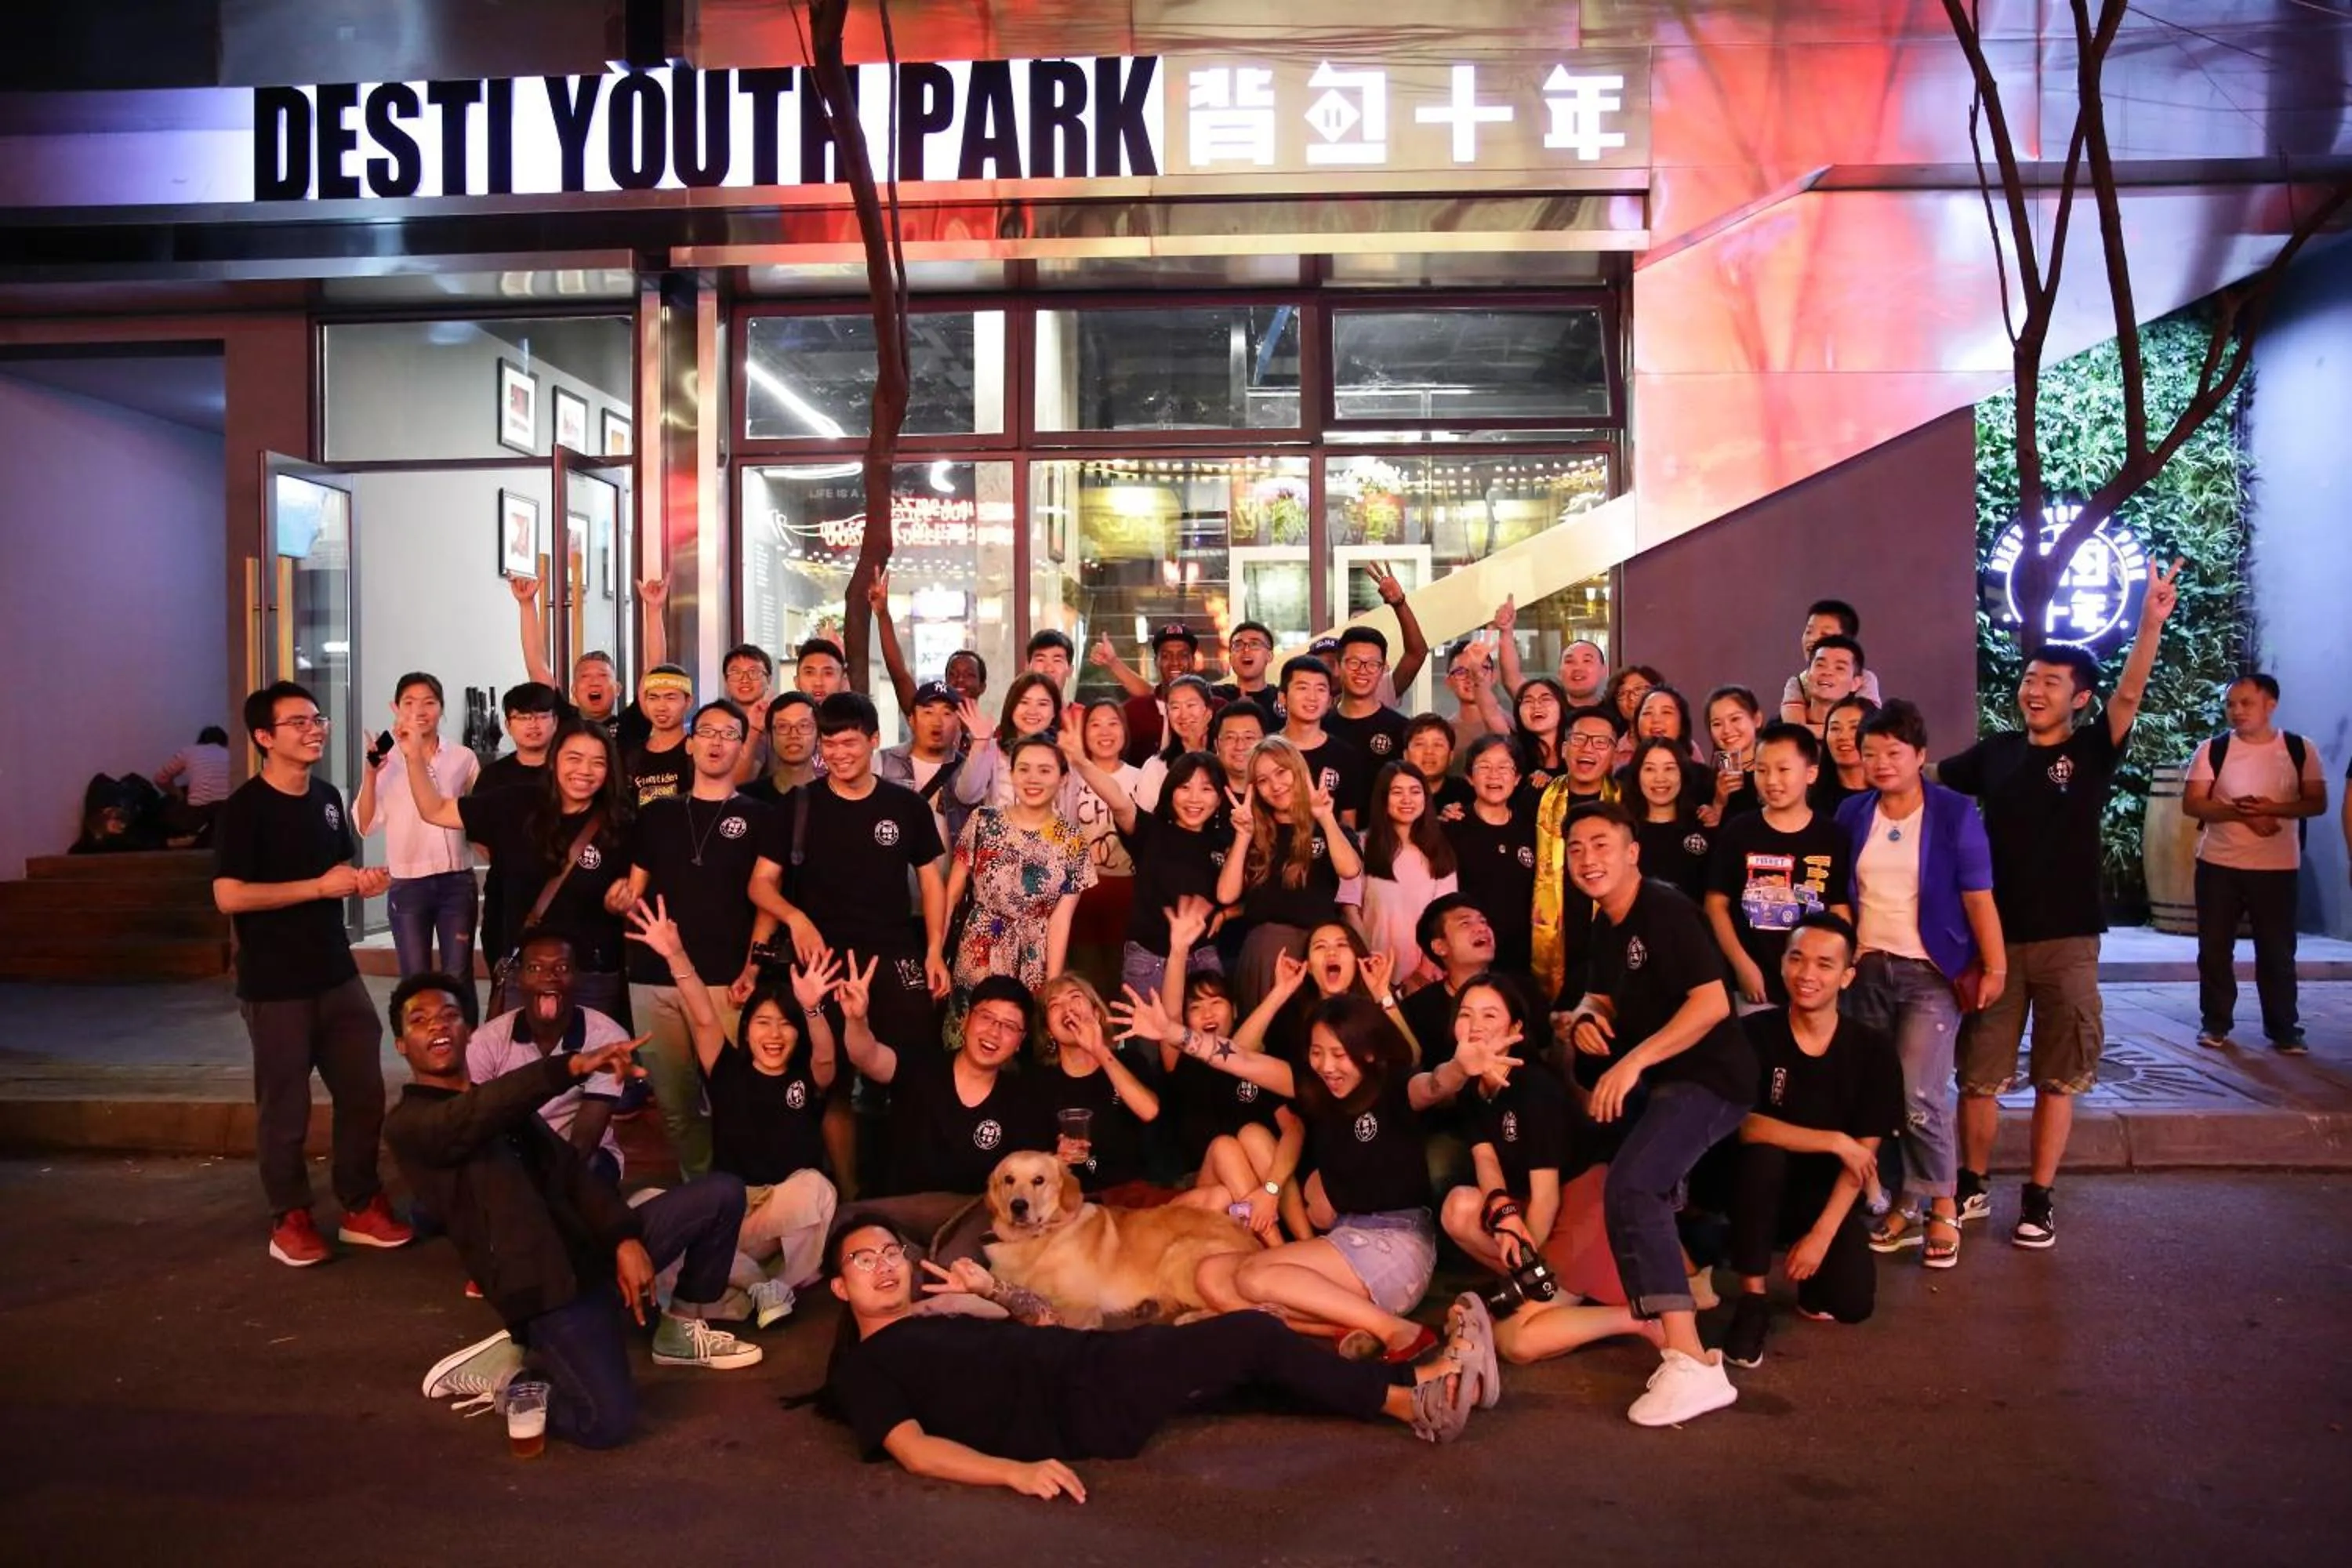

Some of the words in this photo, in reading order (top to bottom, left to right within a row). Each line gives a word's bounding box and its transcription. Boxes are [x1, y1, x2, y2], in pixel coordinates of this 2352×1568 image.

[254, 78, 513, 201] DESTI
[898, 56, 1158, 180] PARK
[1189, 60, 1624, 166] 背包十年
